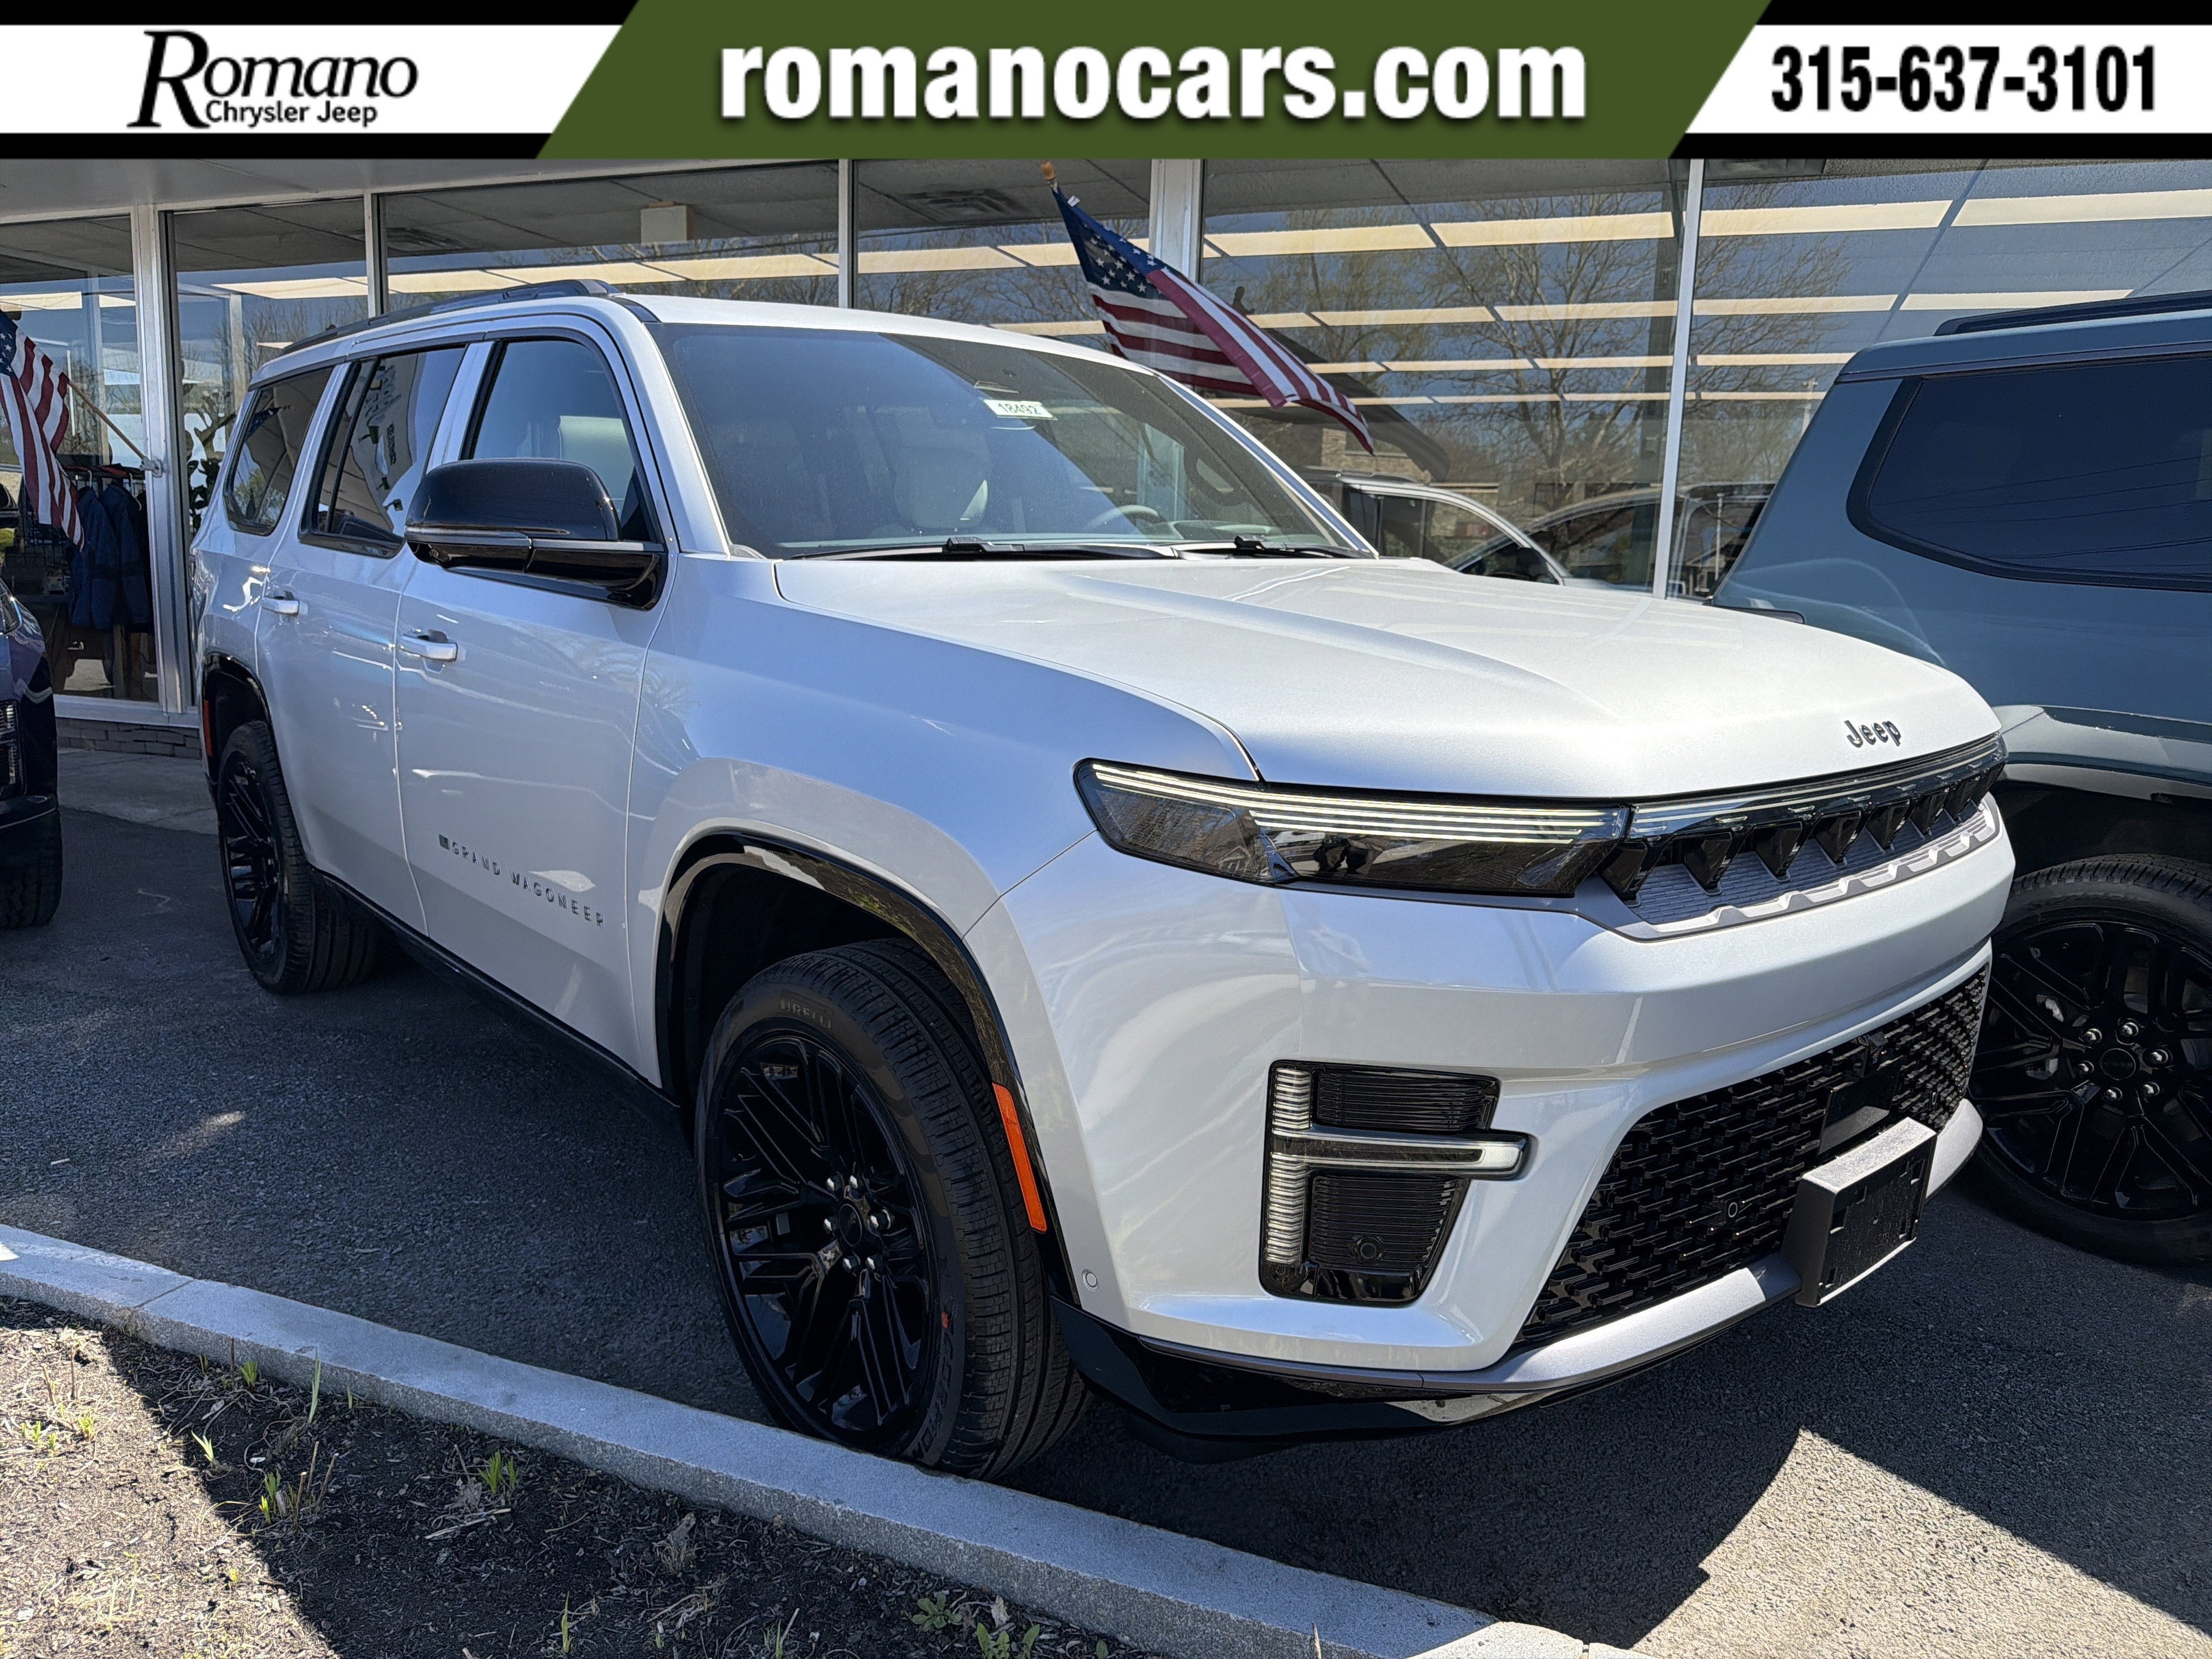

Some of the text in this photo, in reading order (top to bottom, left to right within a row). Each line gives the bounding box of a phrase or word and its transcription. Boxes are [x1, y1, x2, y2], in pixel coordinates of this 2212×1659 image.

[998, 403, 1042, 415] 18492
[1843, 720, 1901, 748] Jeep
[452, 841, 606, 929] GRAND WAGONEER
